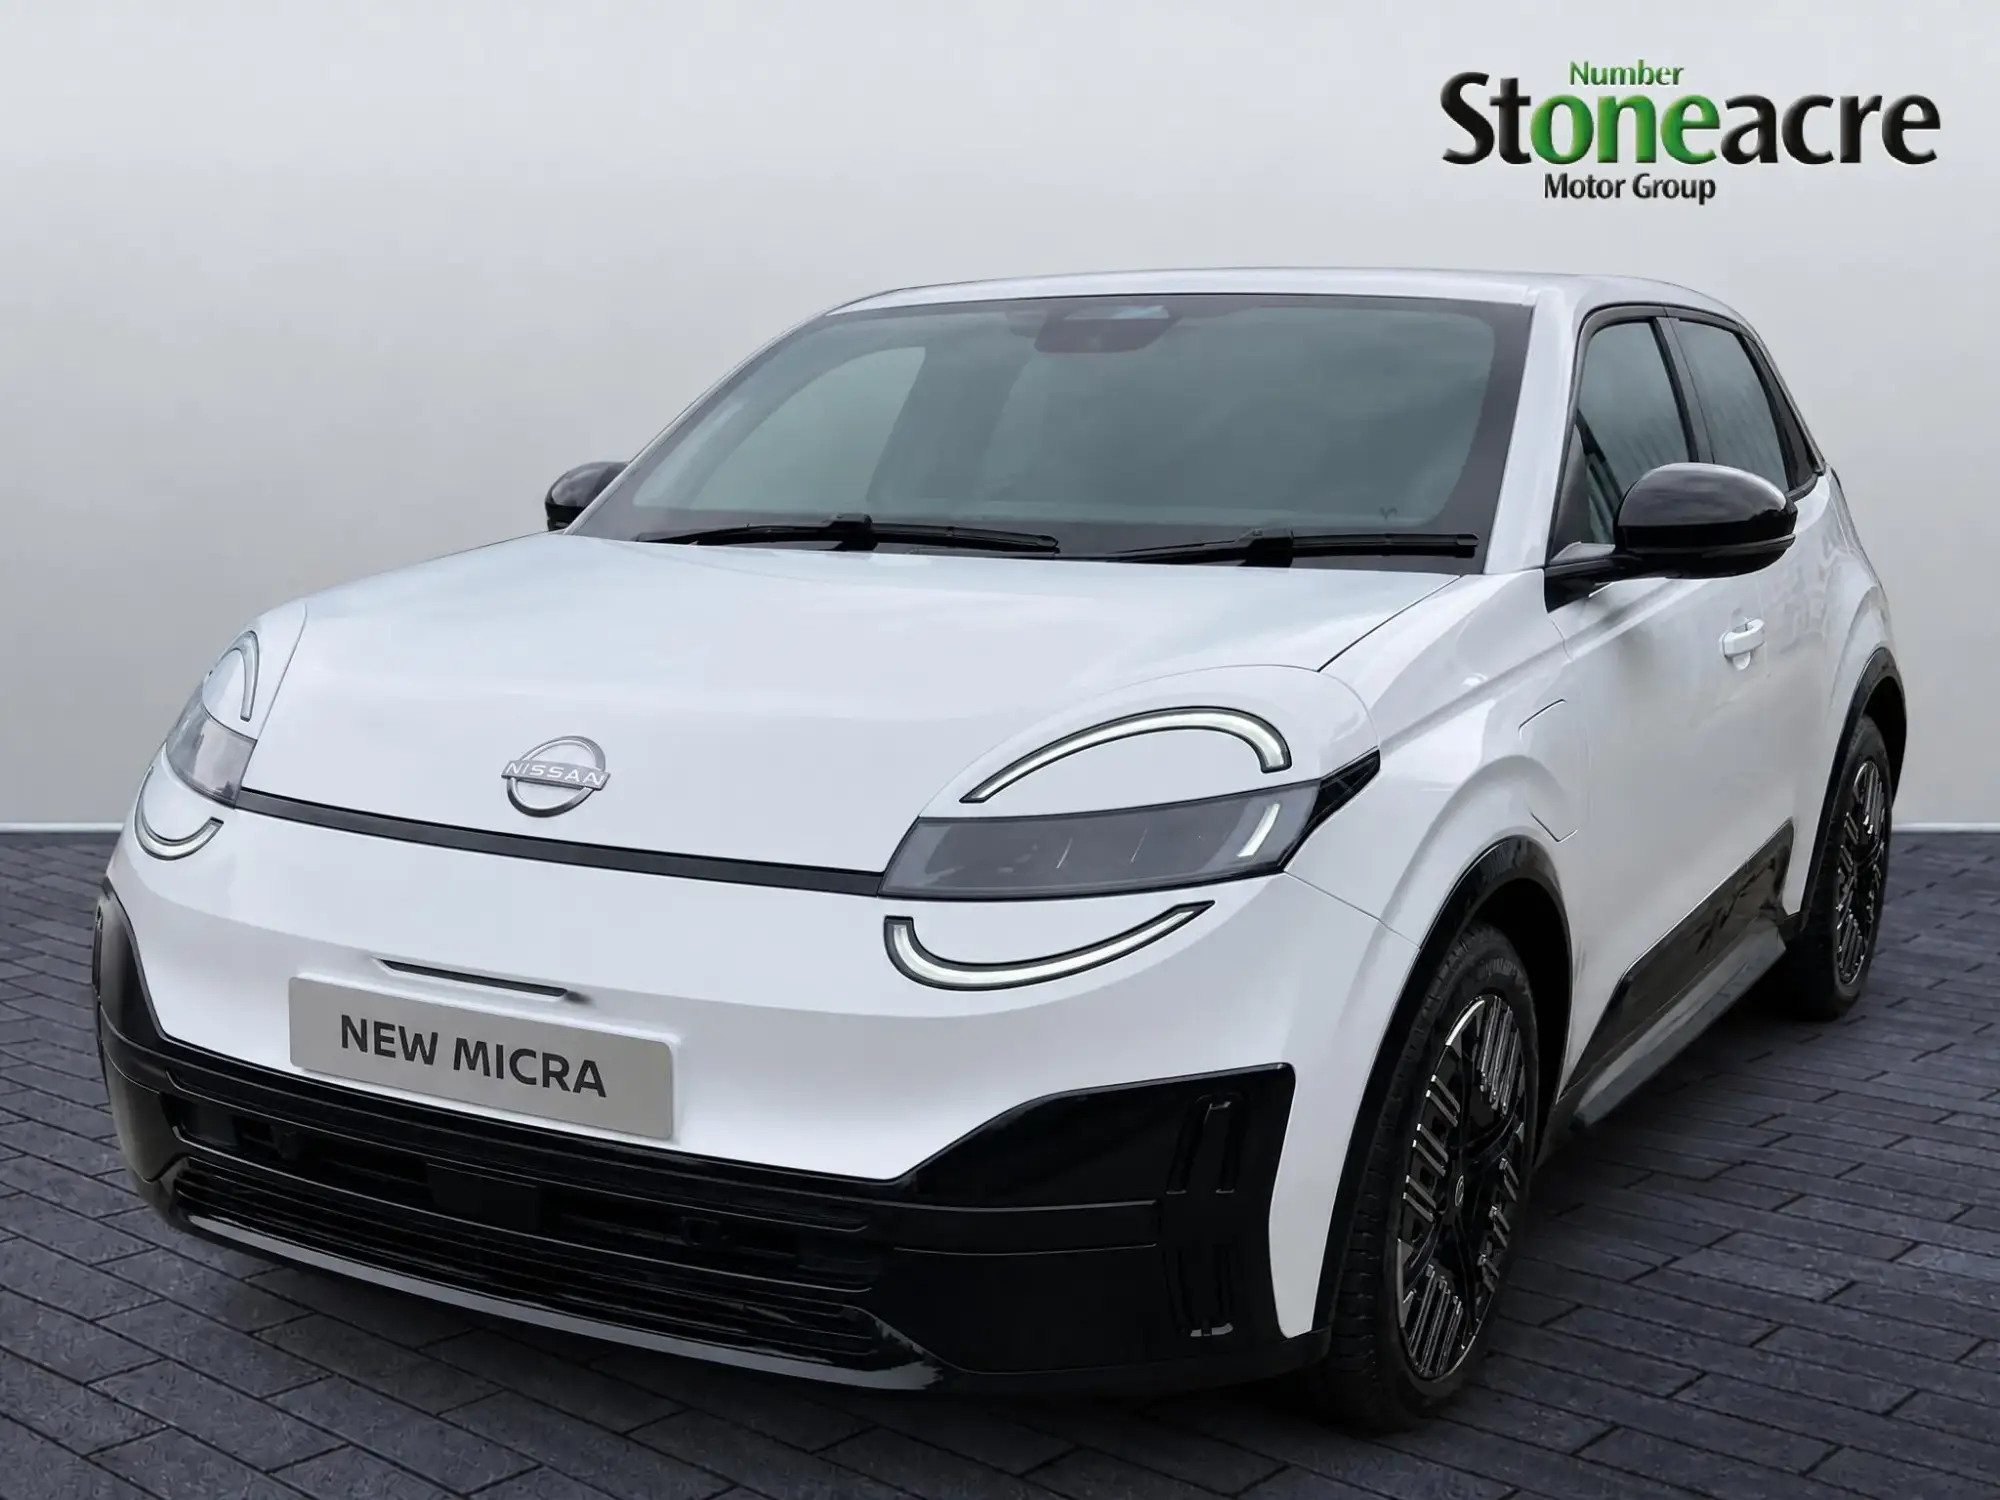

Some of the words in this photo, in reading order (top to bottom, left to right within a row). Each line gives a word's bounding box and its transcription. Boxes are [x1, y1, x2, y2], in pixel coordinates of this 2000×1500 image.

[505, 762, 605, 786] NISSAN
[340, 1014, 438, 1066] NEW
[453, 1037, 607, 1098] MICRA
